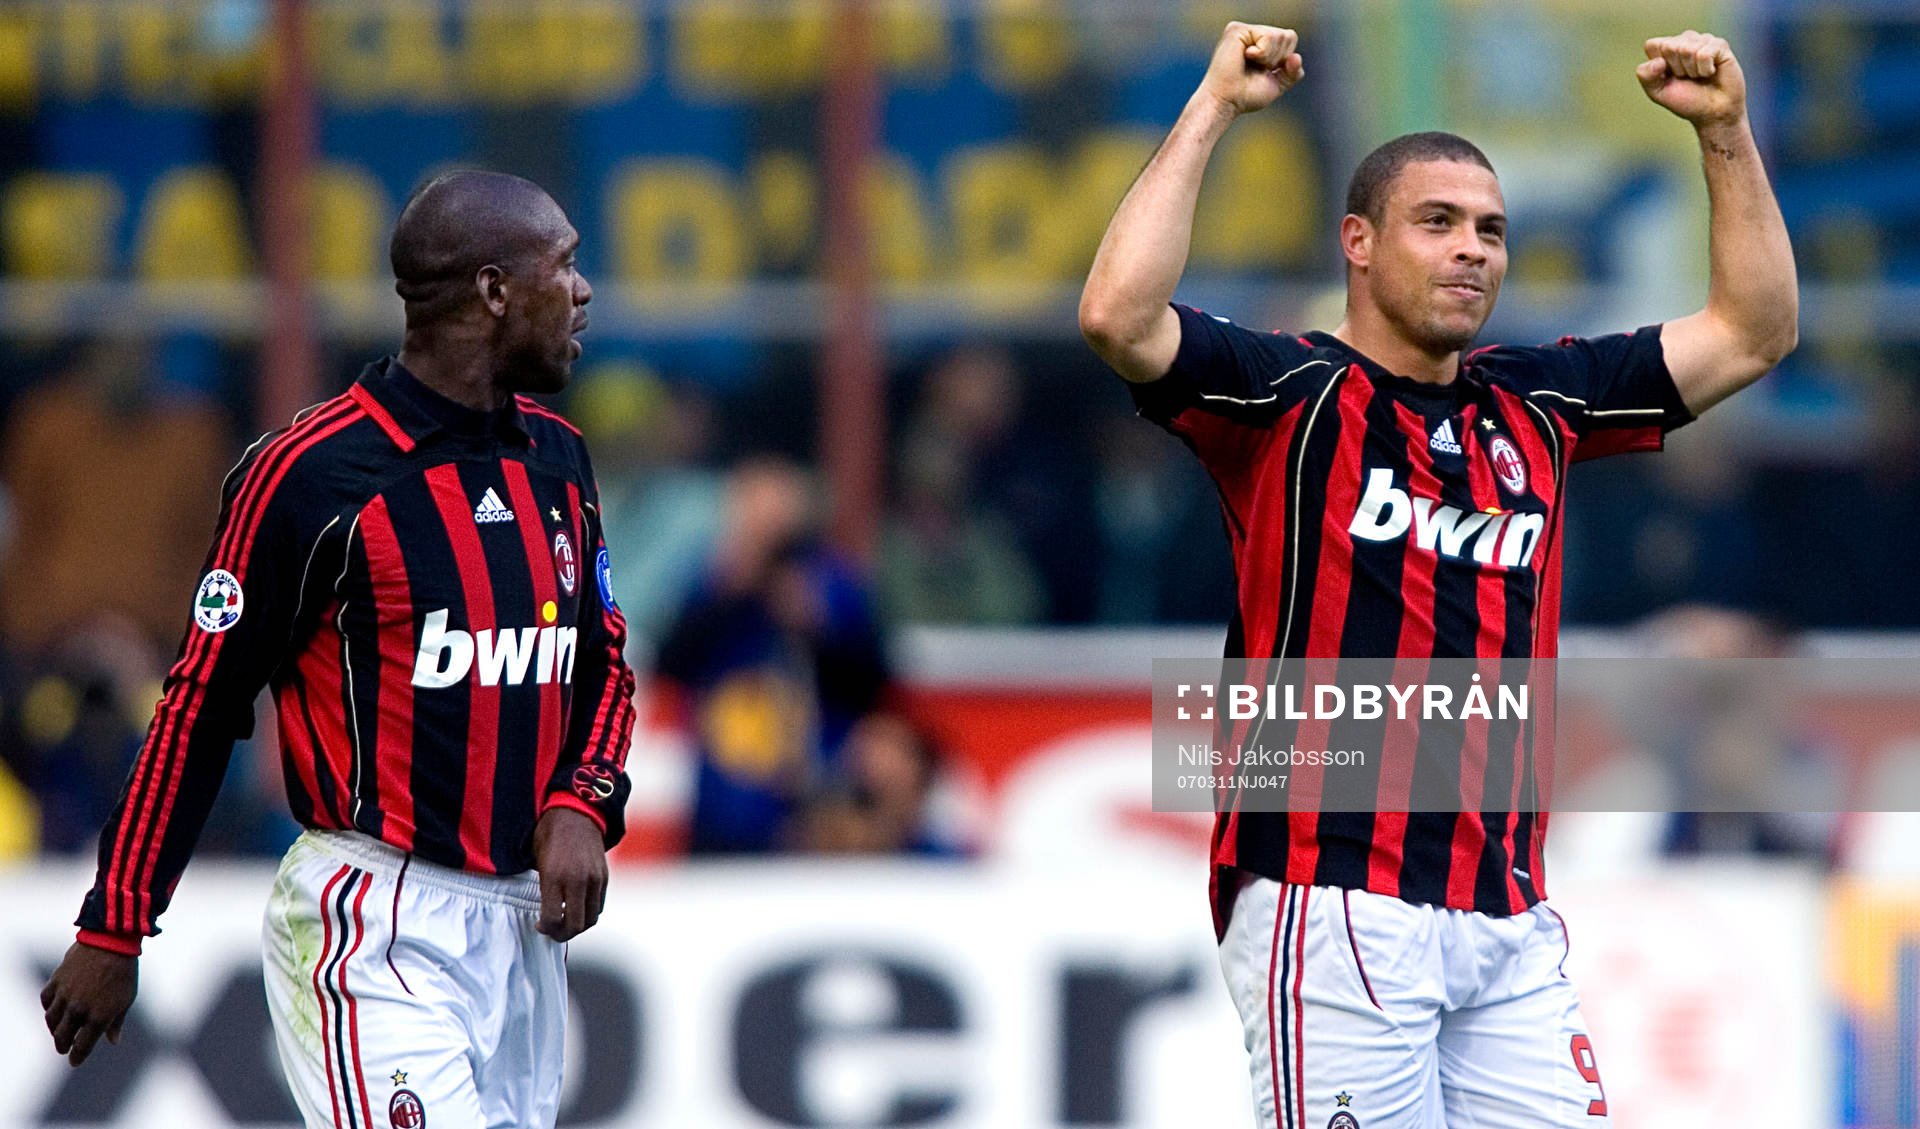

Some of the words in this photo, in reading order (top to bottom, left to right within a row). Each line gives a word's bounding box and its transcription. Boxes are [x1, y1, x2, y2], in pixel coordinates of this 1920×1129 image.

[1430, 438, 1462, 455] adidas
[474, 510, 515, 523] adidas
[1348, 467, 1545, 567] bwin
[411, 600, 577, 688] bwin
[1570, 1034, 1608, 1117] 9
